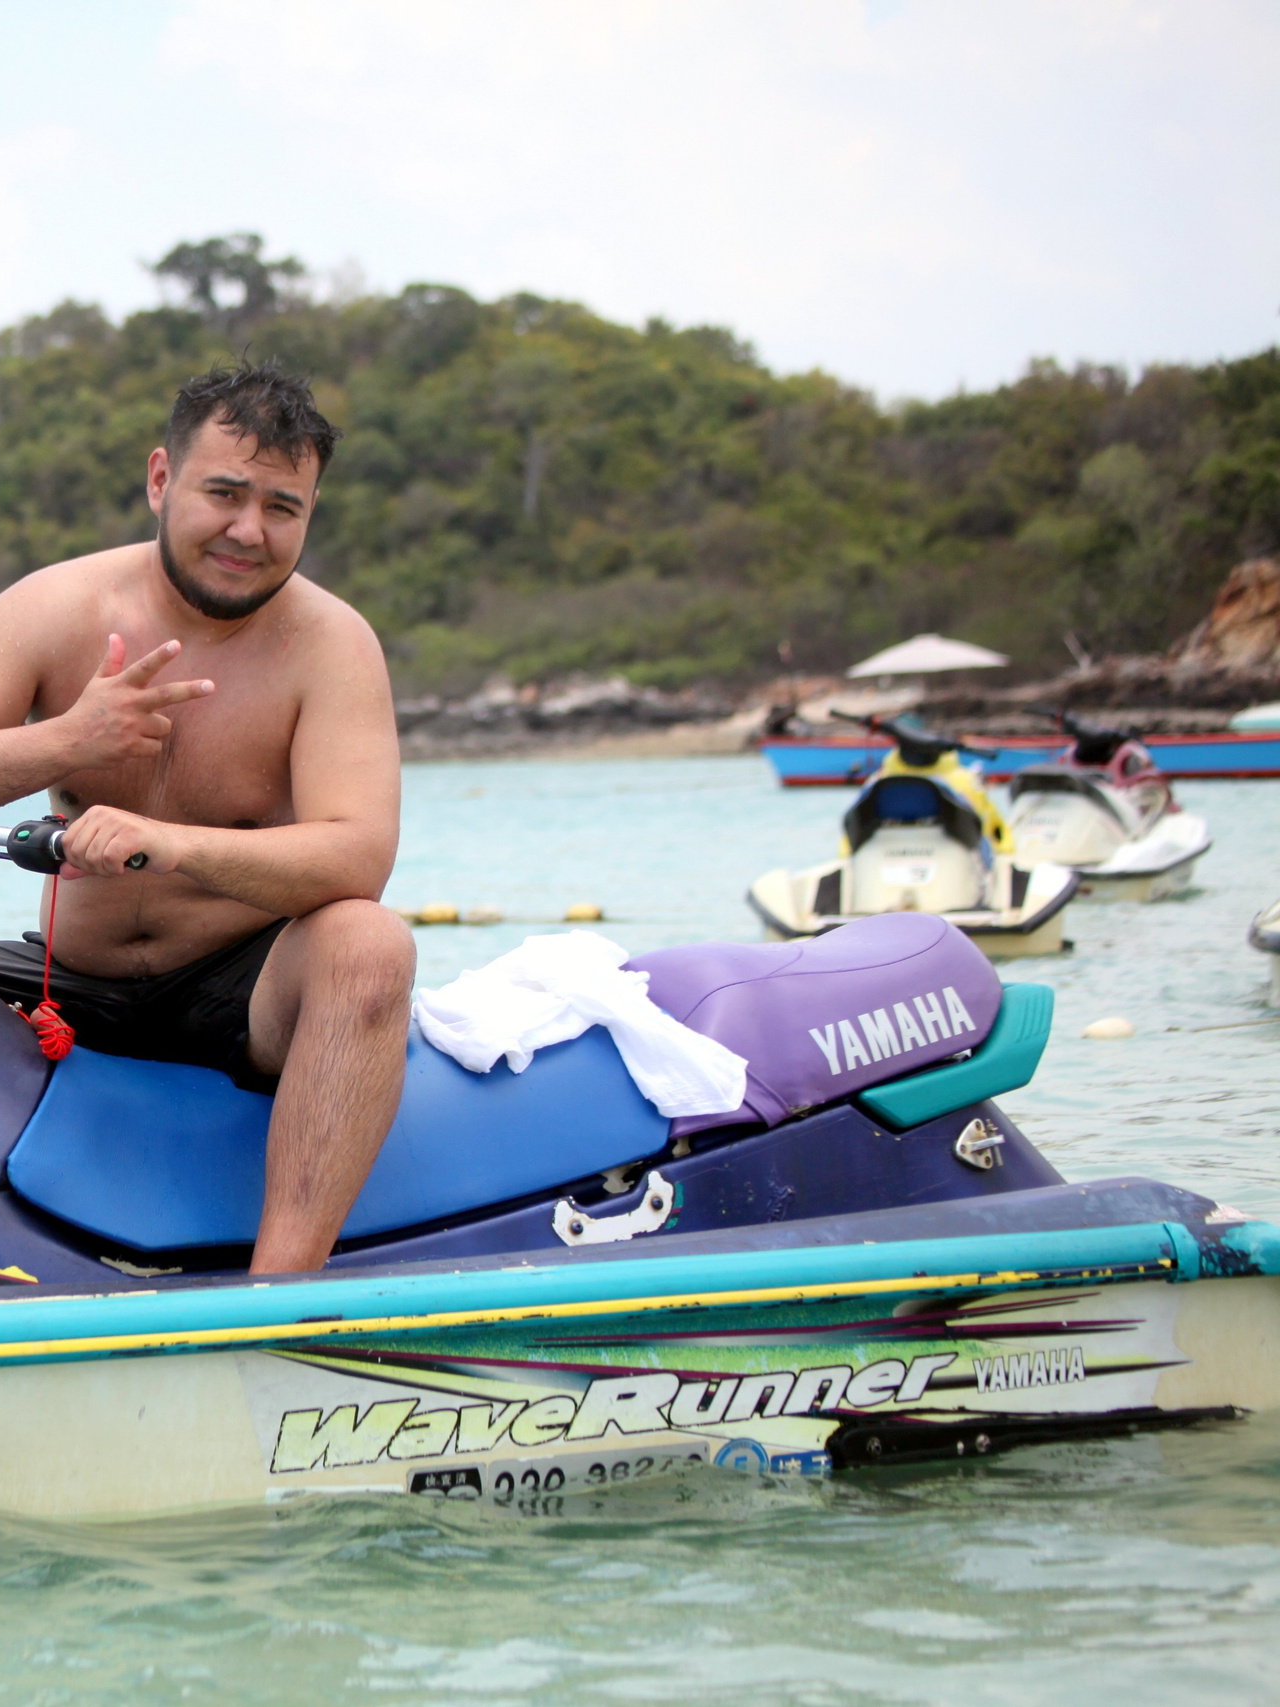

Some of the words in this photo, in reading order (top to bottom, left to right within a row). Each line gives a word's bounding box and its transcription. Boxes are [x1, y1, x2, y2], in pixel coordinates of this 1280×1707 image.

[808, 986, 976, 1076] YAMAHA
[270, 1352, 959, 1473] WaveRunner
[973, 1347, 1086, 1394] YAMAHA
